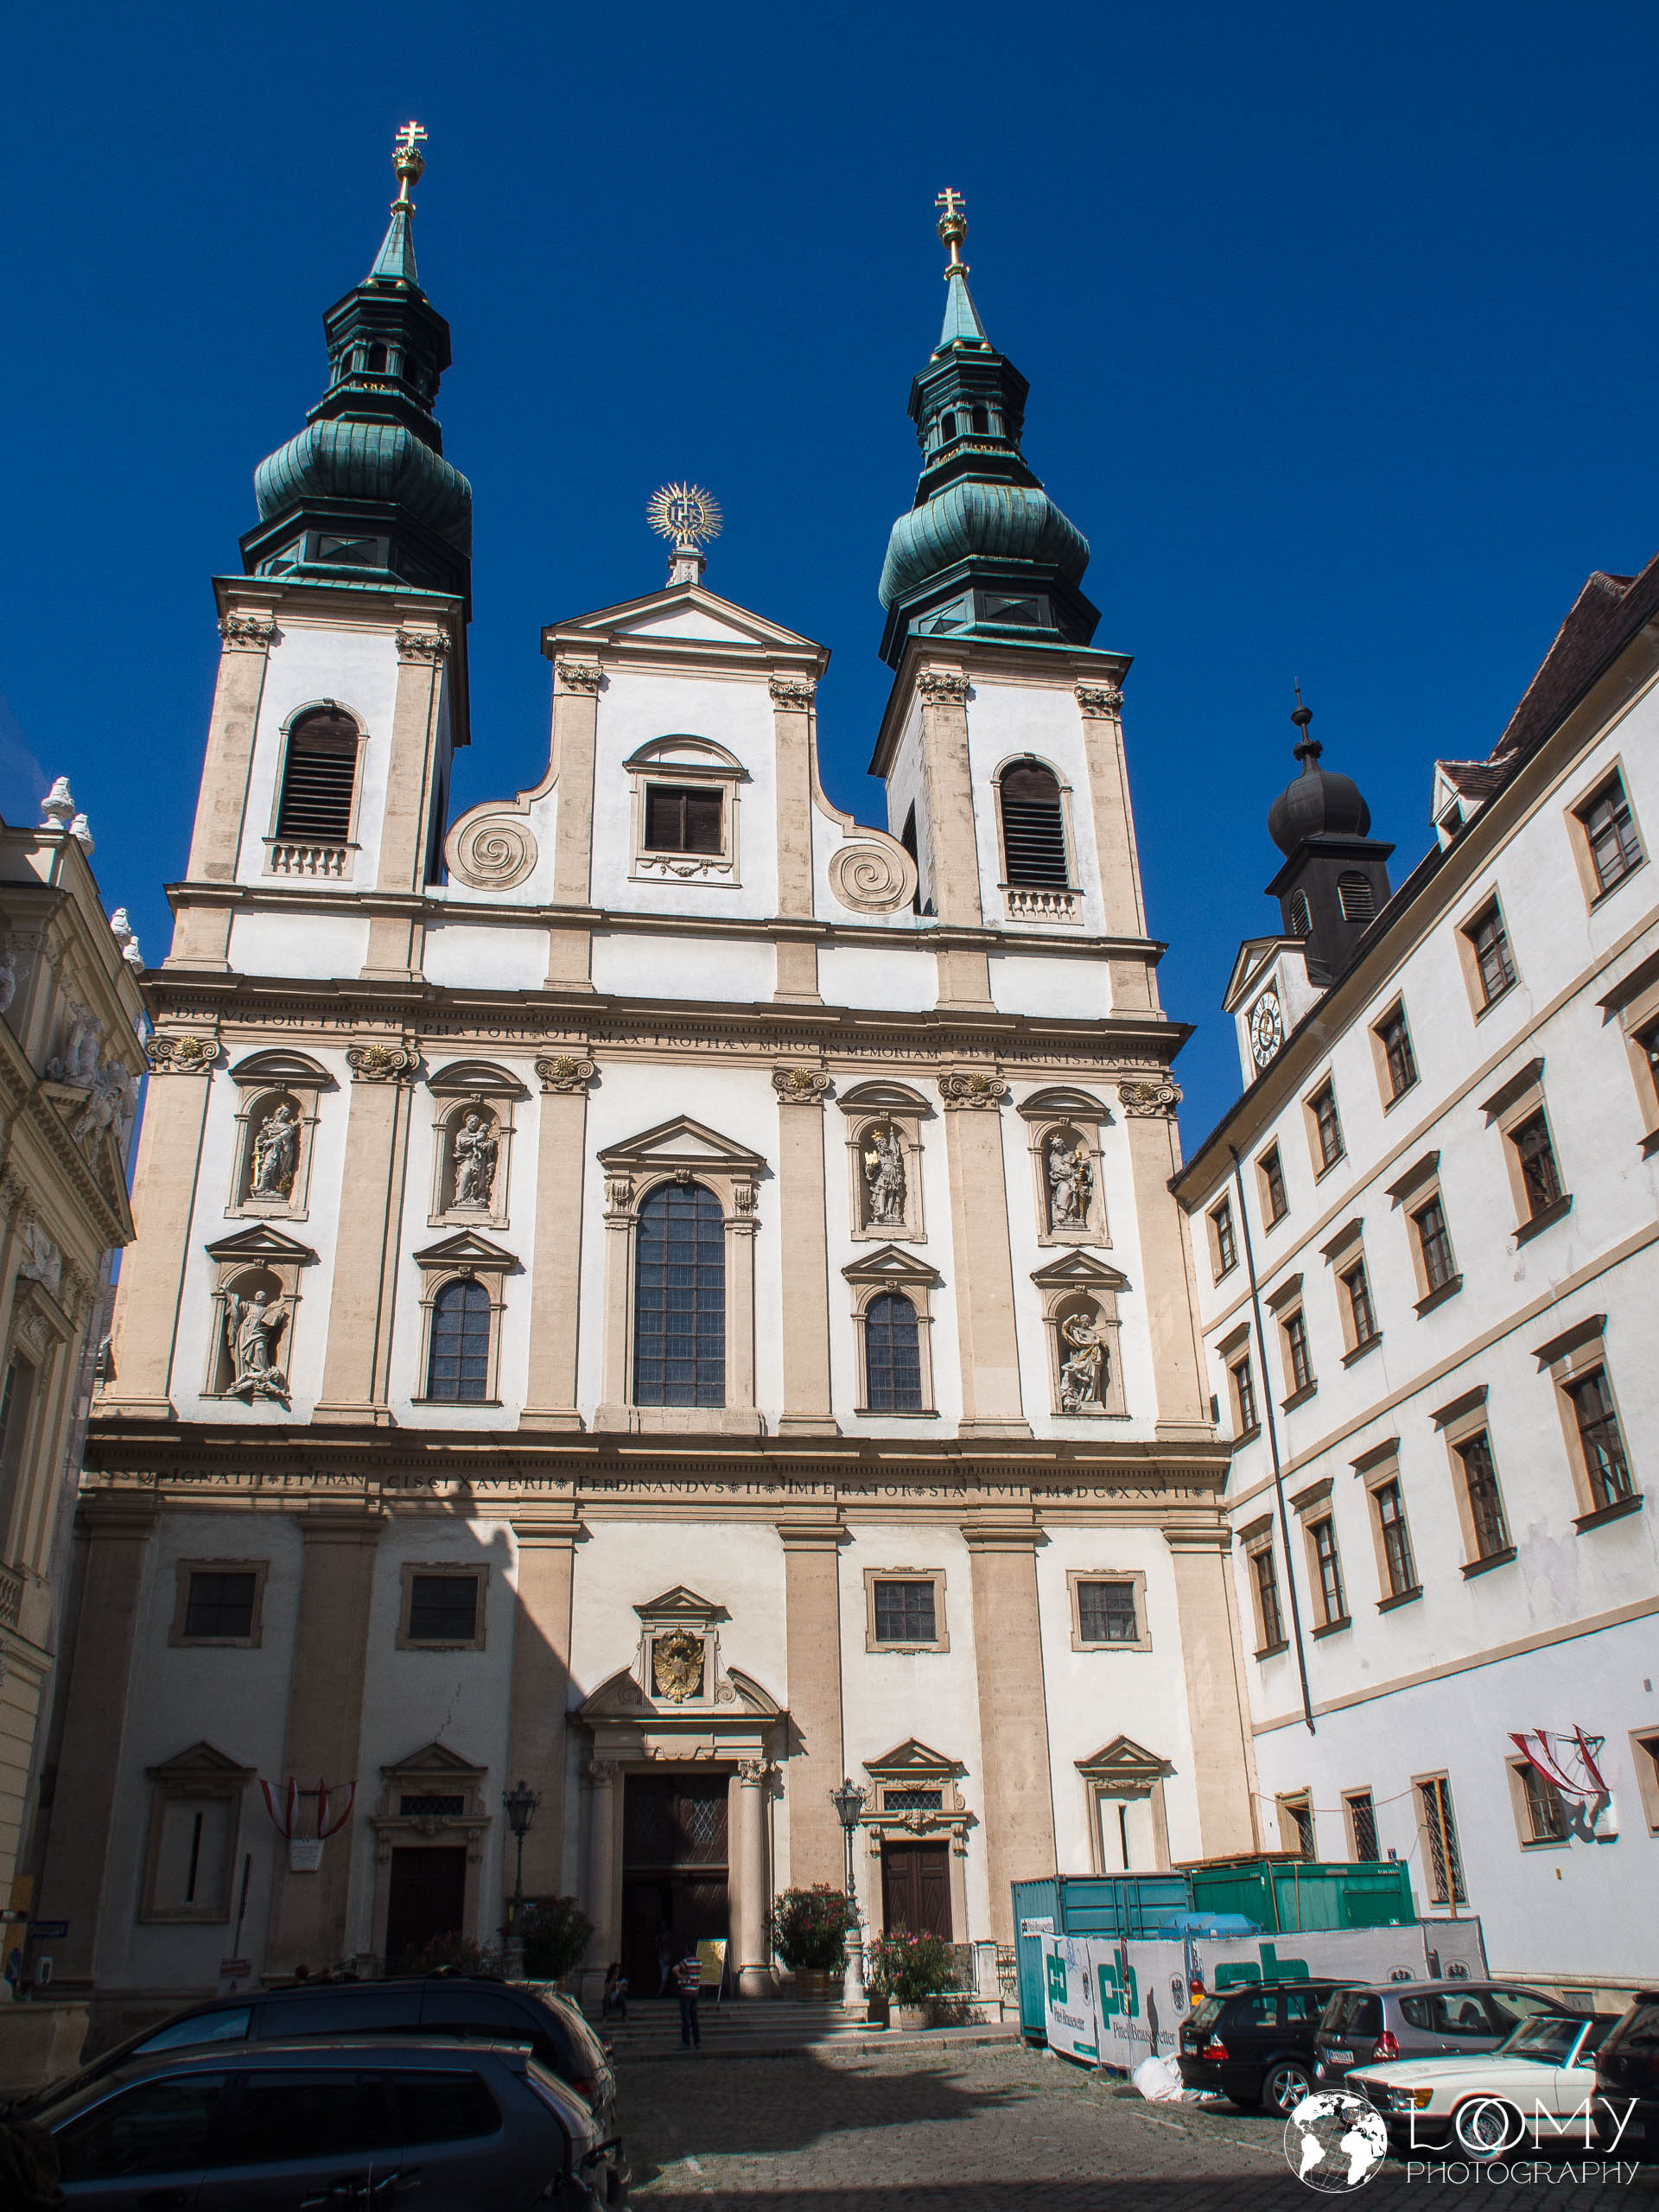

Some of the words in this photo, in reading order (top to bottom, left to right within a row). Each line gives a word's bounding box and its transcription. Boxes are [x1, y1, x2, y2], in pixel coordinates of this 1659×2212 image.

[175, 1007, 216, 1020] DEO
[779, 1040, 819, 1052] HOC
[822, 1044, 841, 1054] IN
[847, 1045, 940, 1059] MEMORIAM
[578, 1476, 725, 1494] FERDINANDVS
